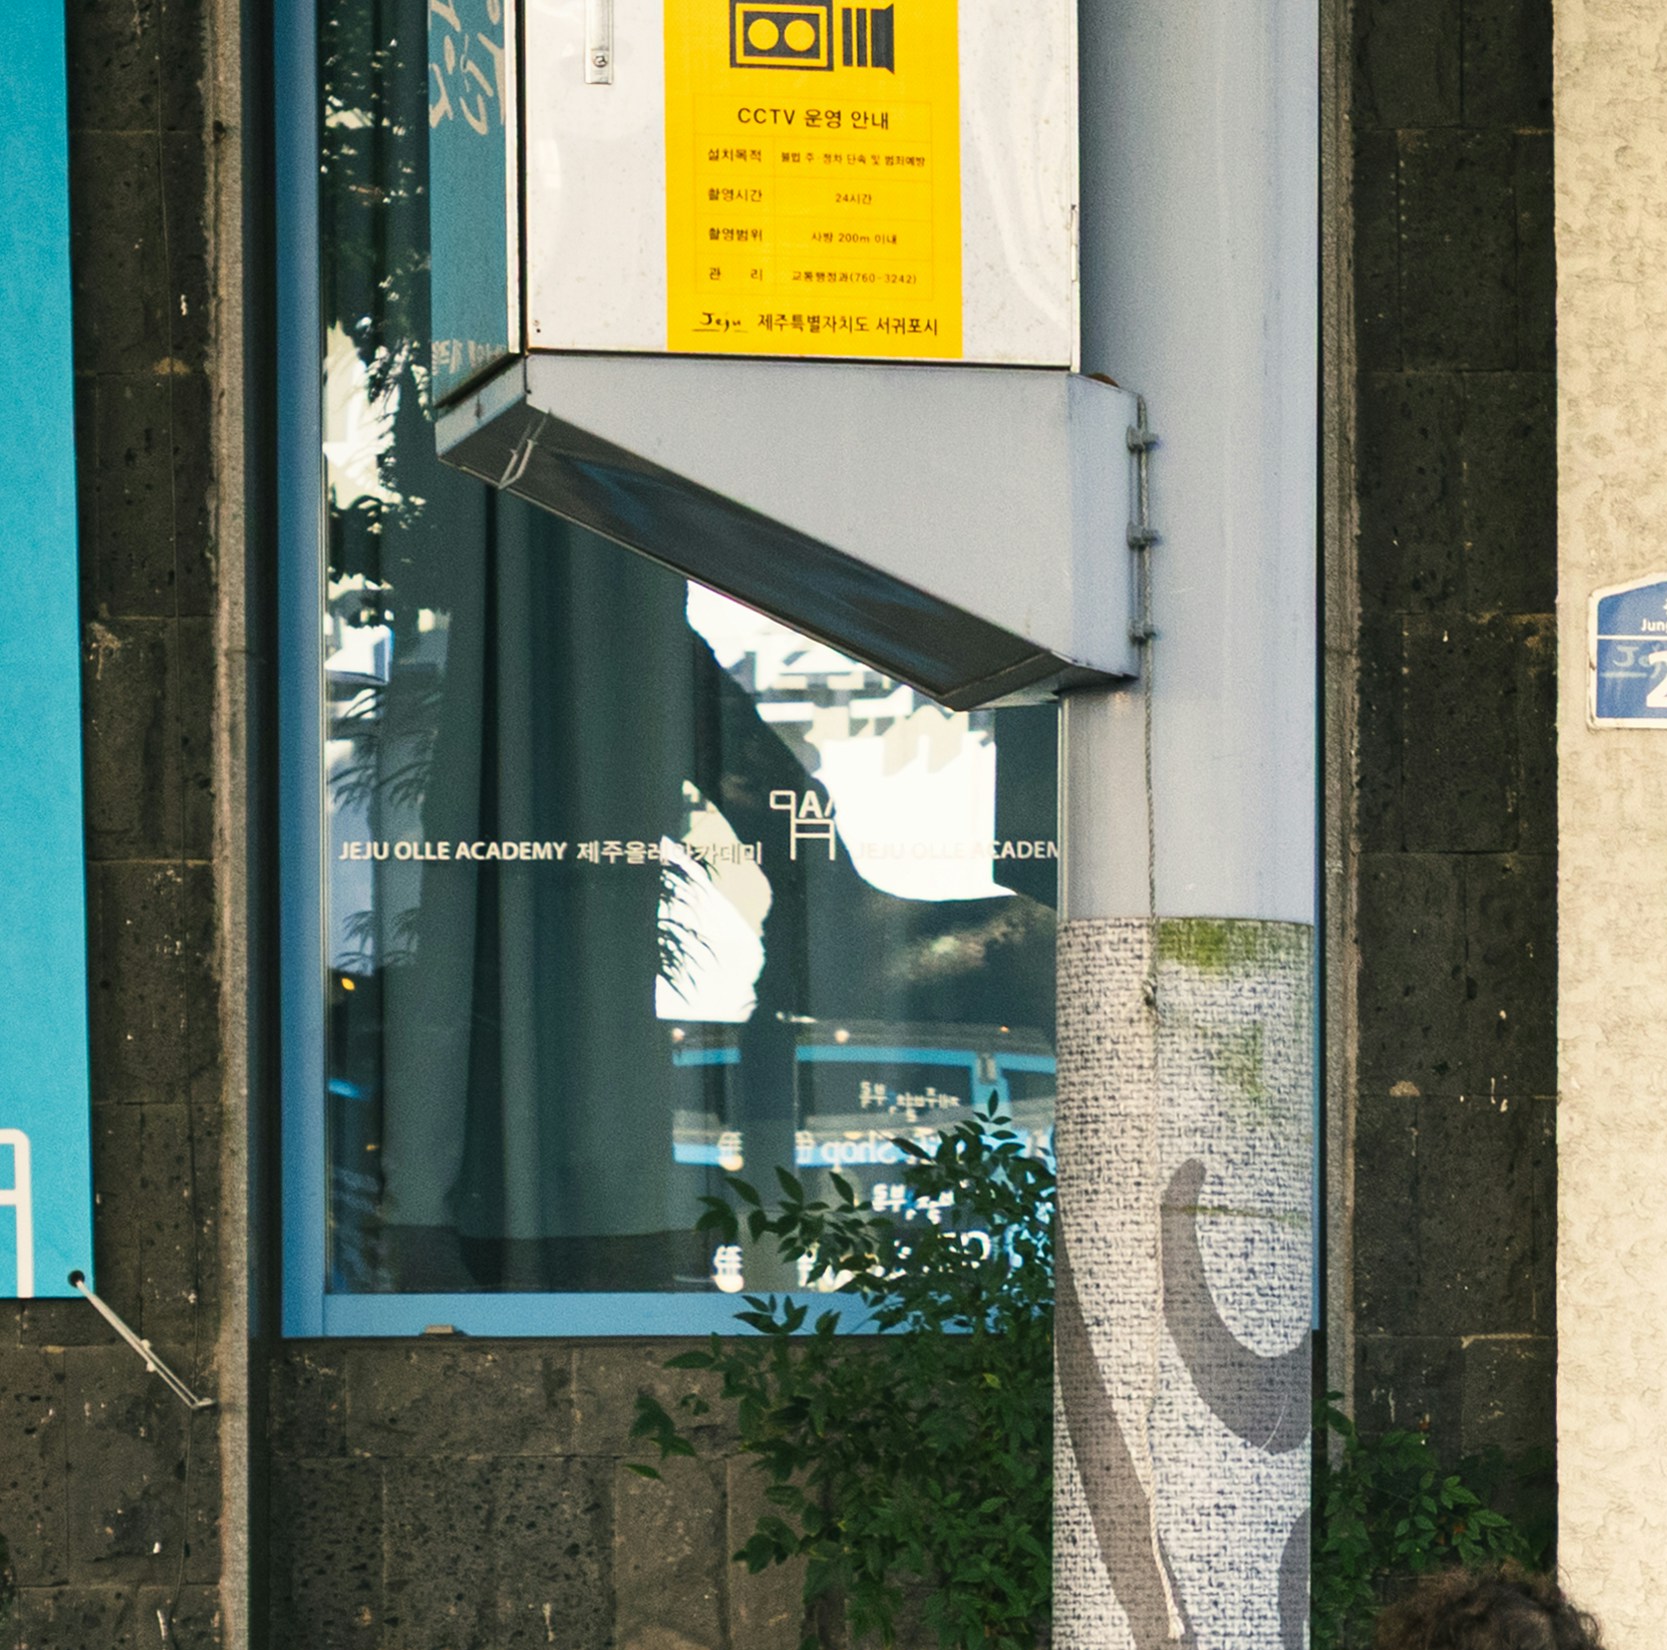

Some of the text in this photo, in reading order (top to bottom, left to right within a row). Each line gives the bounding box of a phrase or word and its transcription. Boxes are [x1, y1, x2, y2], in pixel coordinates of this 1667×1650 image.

[737, 107, 889, 131] CCTV 운영 안내
[707, 148, 762, 162] 설치목적
[707, 187, 763, 203] 촬영시간
[835, 193, 873, 205] 24시간
[708, 227, 763, 242] 촬영범위
[838, 232, 871, 244] 200m
[875, 233, 898, 245] 이내
[757, 313, 871, 334] 제주특별자치도
[875, 316, 938, 337] 서귀포시
[338, 841, 389, 861] JEJU
[394, 841, 451, 861] OLLE
[455, 841, 568, 861] ACADEMY
